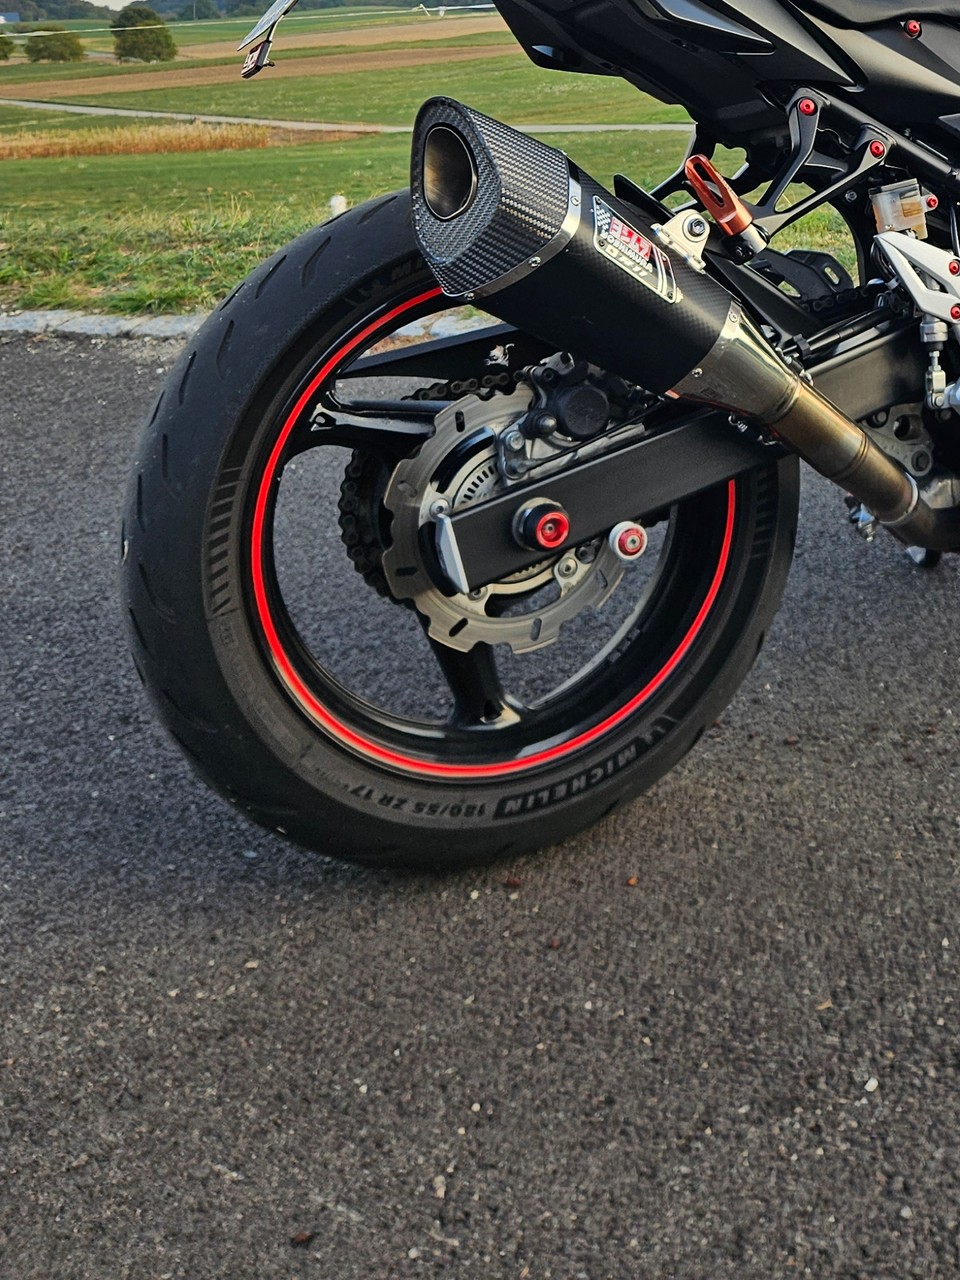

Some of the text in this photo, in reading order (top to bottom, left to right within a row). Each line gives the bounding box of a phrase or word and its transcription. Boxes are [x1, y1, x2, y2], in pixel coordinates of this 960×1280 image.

[600, 229, 653, 273] YOSHIMURA
[350, 744, 638, 819] MICHELIN 180/55 ZR 17
